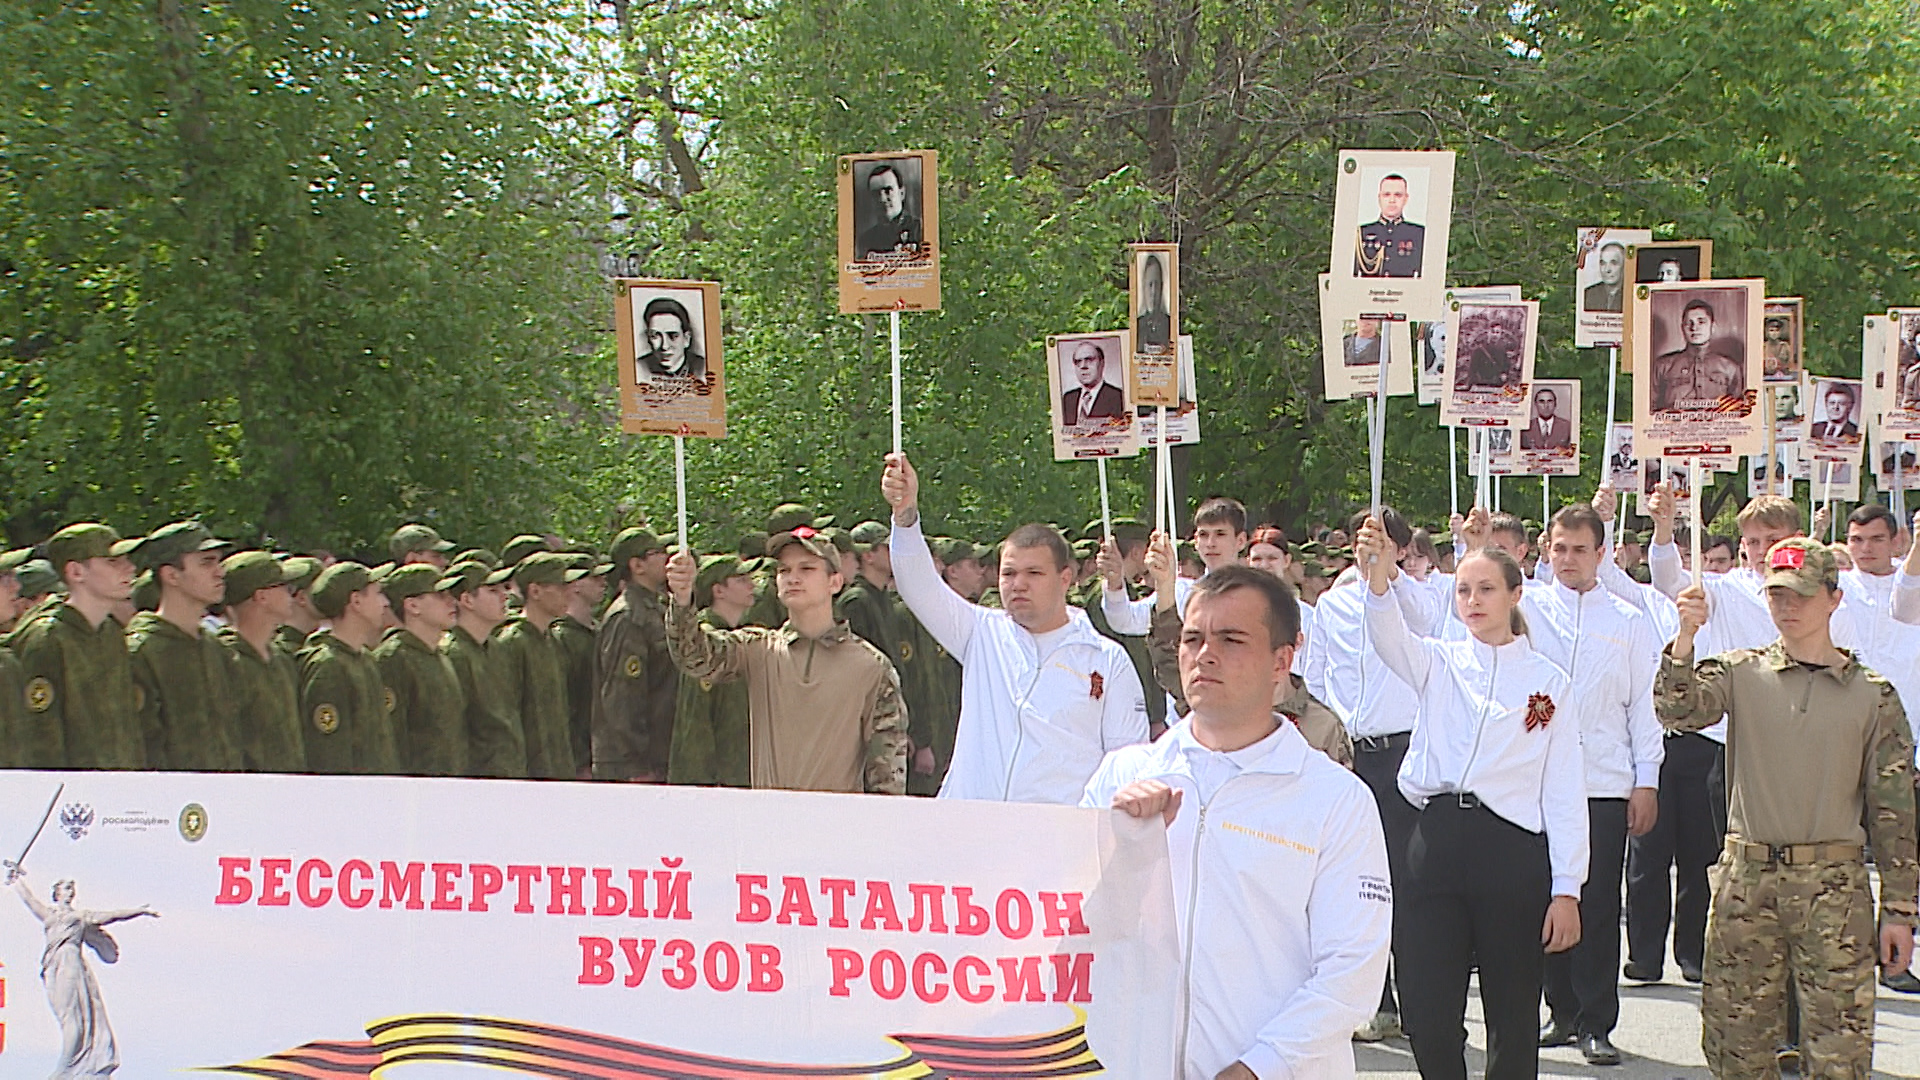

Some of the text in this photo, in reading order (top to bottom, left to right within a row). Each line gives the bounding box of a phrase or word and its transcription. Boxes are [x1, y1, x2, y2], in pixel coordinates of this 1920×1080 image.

[214, 856, 1091, 941] БЕССМЕРТНЫЙ БАТАЛЬОН
[578, 936, 1095, 1005] ВУЗОВ РОССИИ
